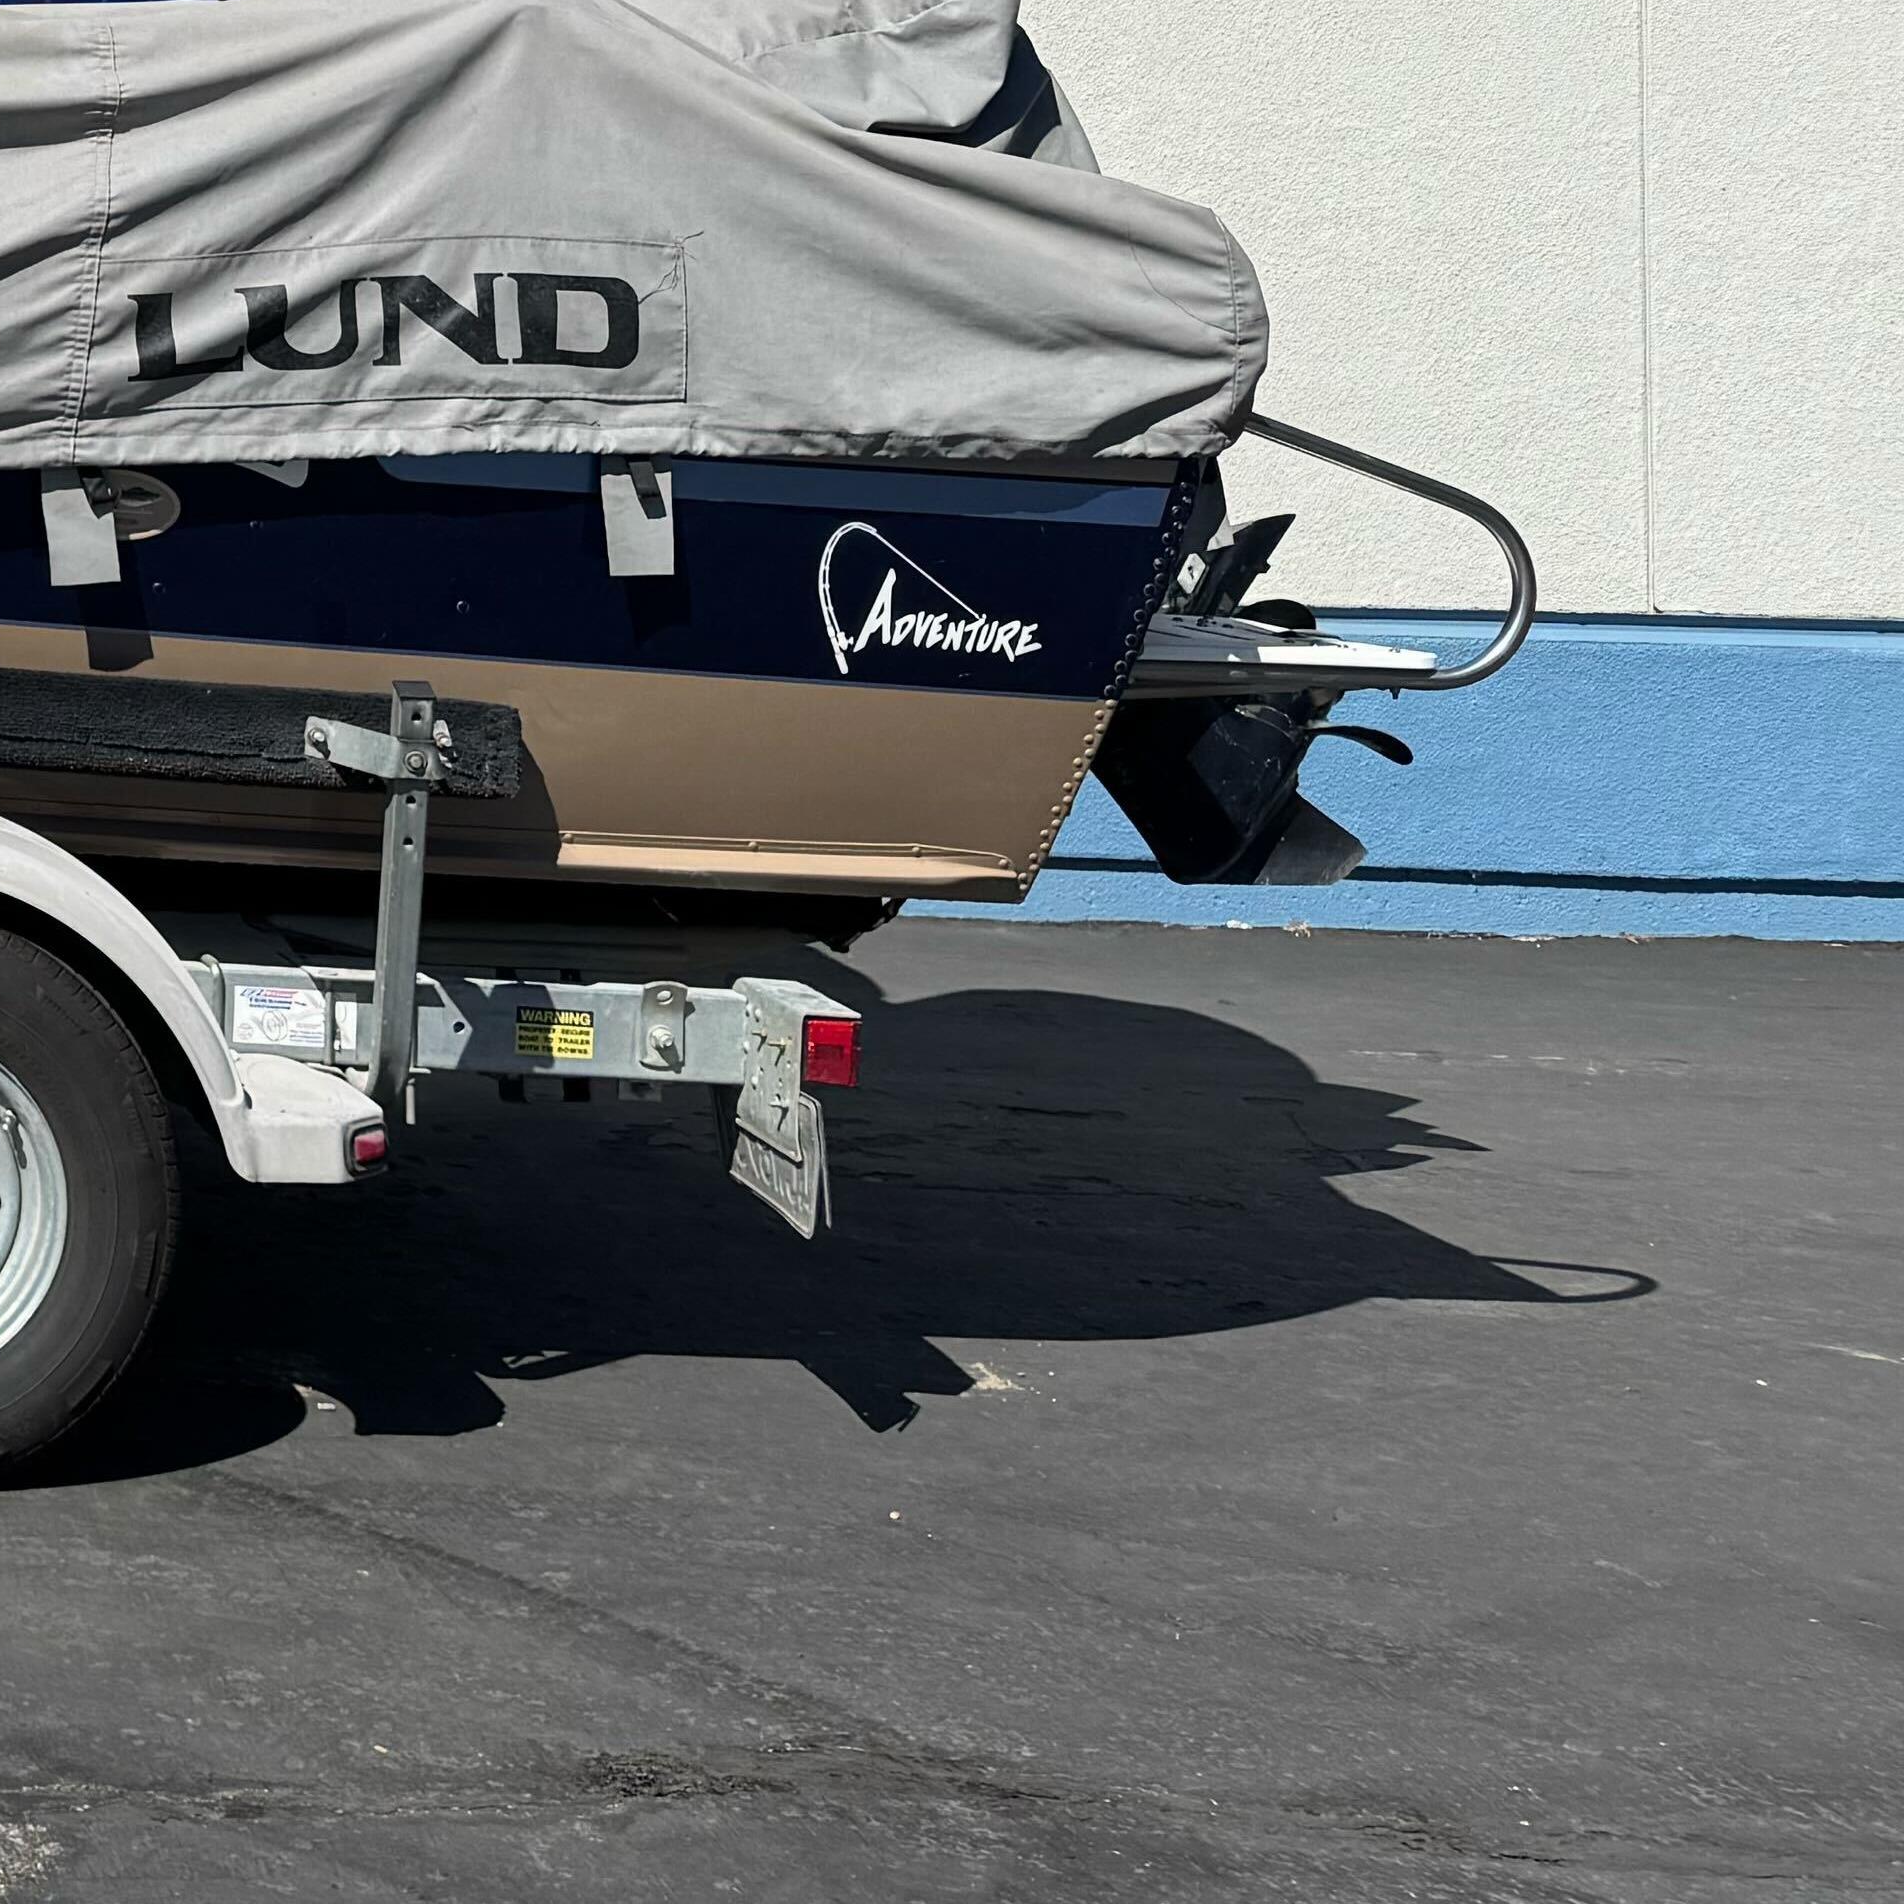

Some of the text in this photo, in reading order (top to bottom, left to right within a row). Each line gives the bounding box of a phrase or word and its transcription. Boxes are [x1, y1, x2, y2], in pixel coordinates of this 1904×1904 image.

[127, 271, 640, 383] LUND
[853, 568, 1042, 662] ADVENTURE
[520, 1009, 591, 1026] WARNING
